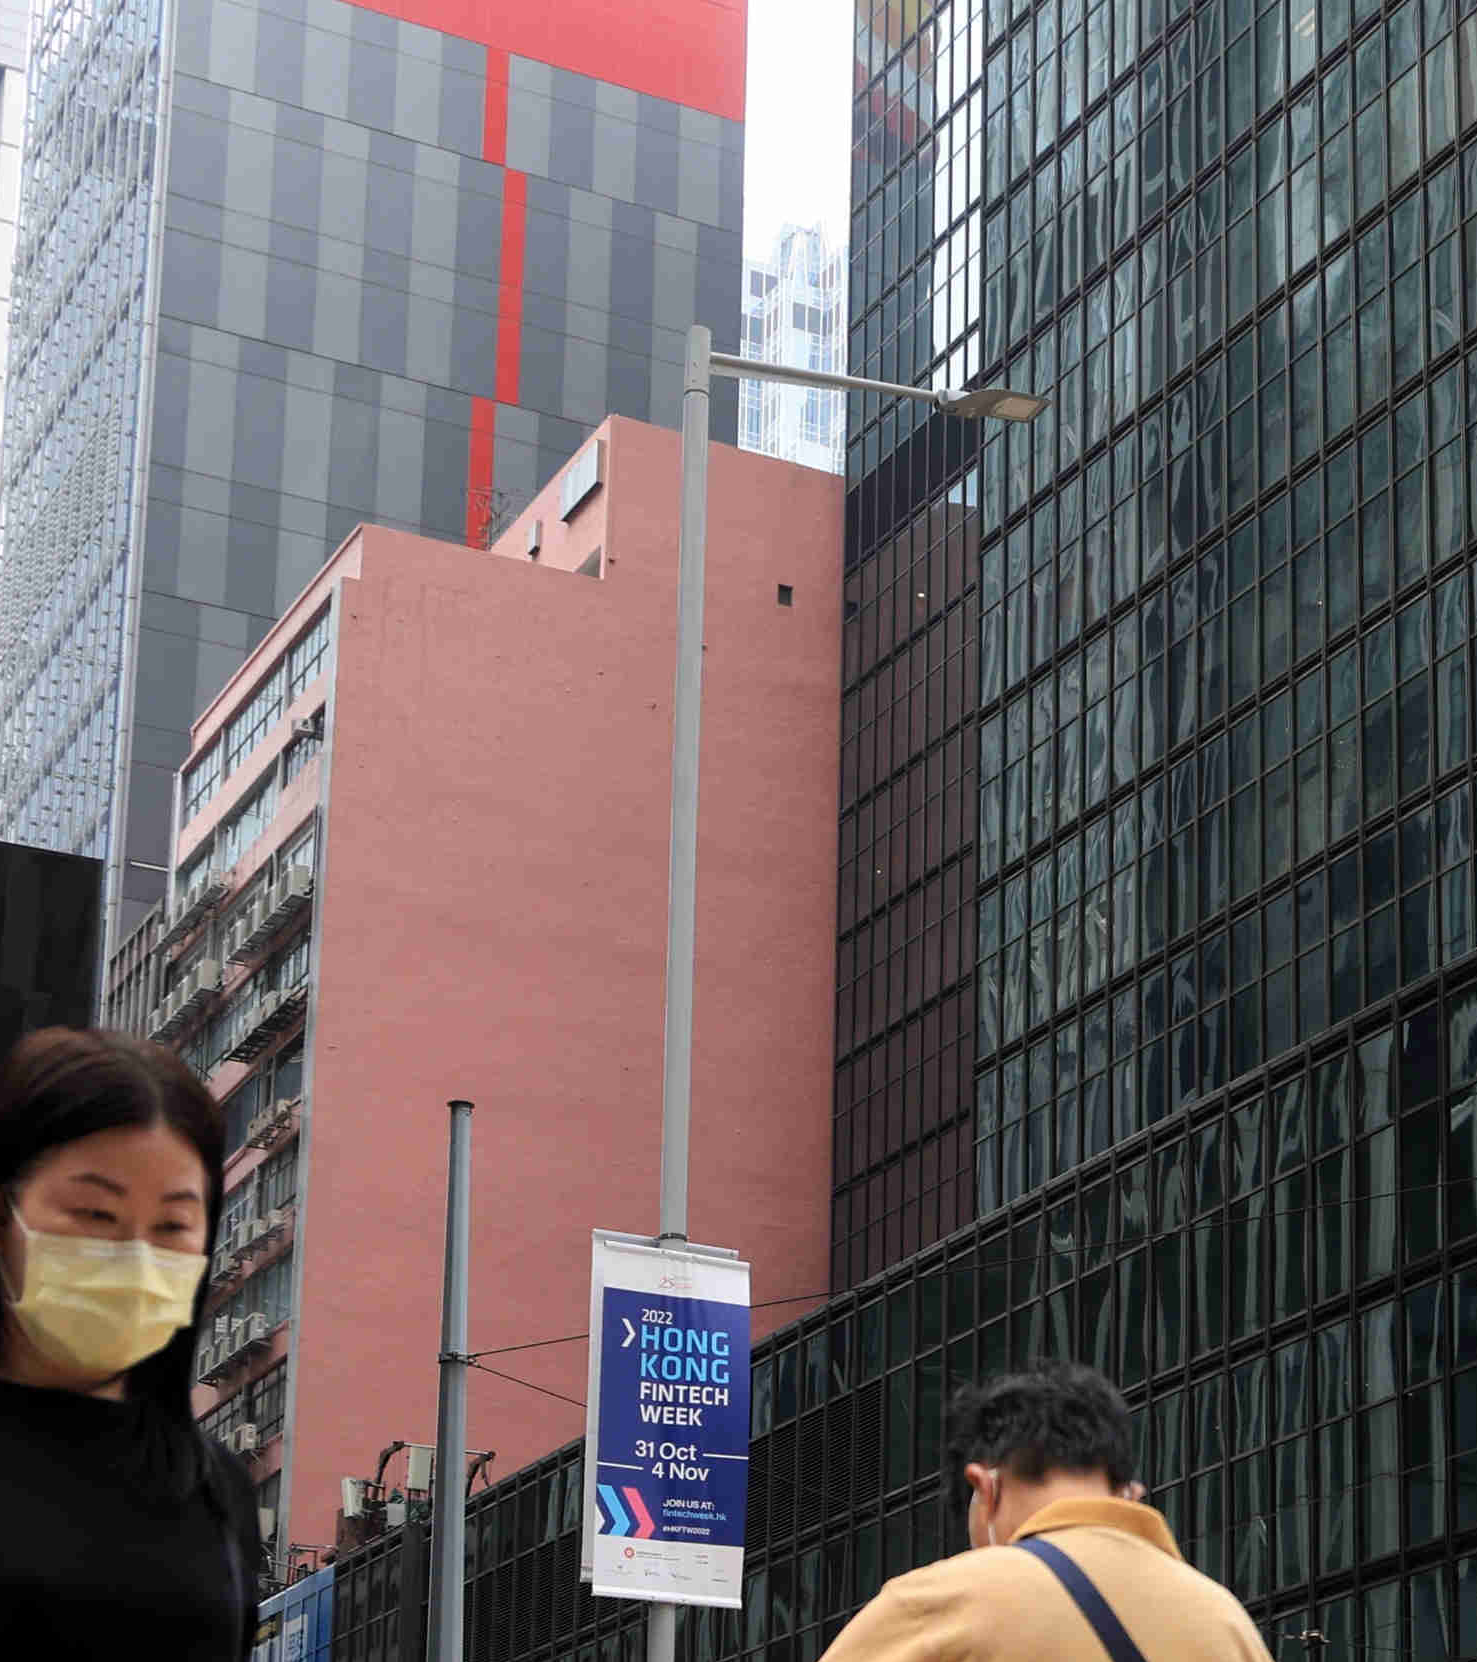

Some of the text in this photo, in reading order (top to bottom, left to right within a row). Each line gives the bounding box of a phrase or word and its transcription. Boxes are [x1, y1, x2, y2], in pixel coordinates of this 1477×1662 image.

[641, 1308, 673, 1325] 2022
[640, 1324, 730, 1356] HONG
[640, 1353, 730, 1384] KONG
[639, 1381, 729, 1406] FINTECH
[639, 1403, 703, 1427] WEEK
[635, 1440, 698, 1461] 31 Oct
[651, 1462, 710, 1481] 4 Nov
[662, 1499, 685, 1508] JOIN
[686, 1500, 700, 1509] US
